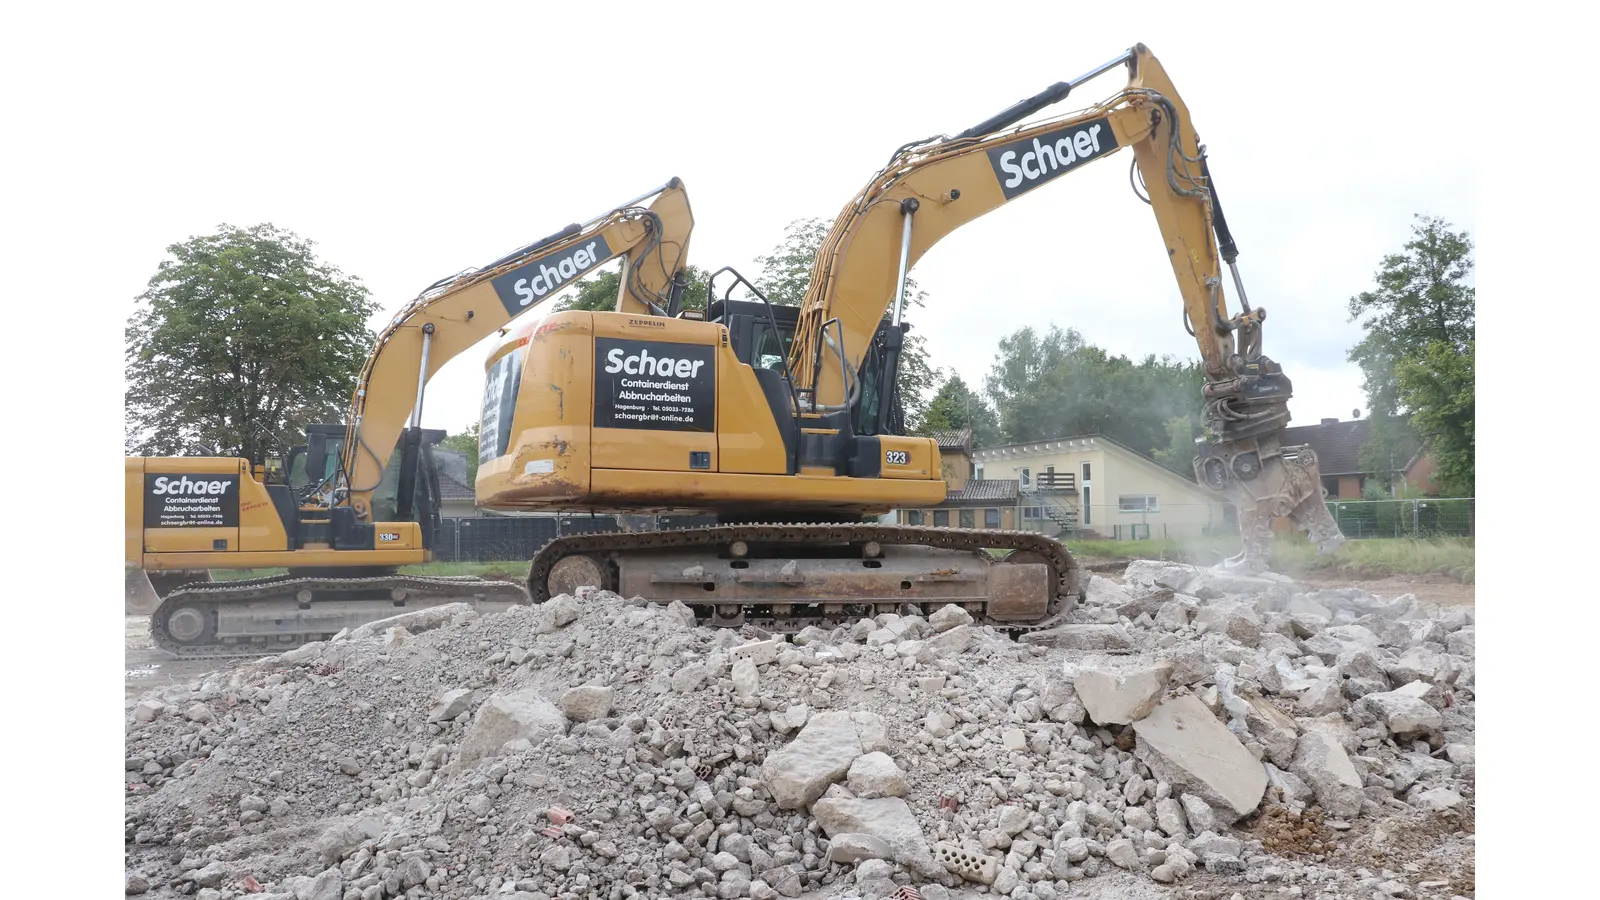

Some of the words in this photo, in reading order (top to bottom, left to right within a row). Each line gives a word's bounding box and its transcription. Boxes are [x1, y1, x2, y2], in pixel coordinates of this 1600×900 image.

[1000, 123, 1101, 188] Schaer
[514, 241, 596, 306] Schaer
[628, 319, 666, 327] ZEPPELIN
[604, 348, 705, 378] Schaer
[620, 378, 690, 391] Containerdienst
[618, 390, 692, 403] Abbrucharbeiten
[614, 403, 646, 412] Hagenburg
[614, 412, 694, 422] schaergbr@t-online.de
[886, 451, 906, 464] 323
[152, 475, 232, 495] Schaer
[165, 496, 219, 504] Containerdienst
[163, 504, 221, 512] Abbrucharbeiten
